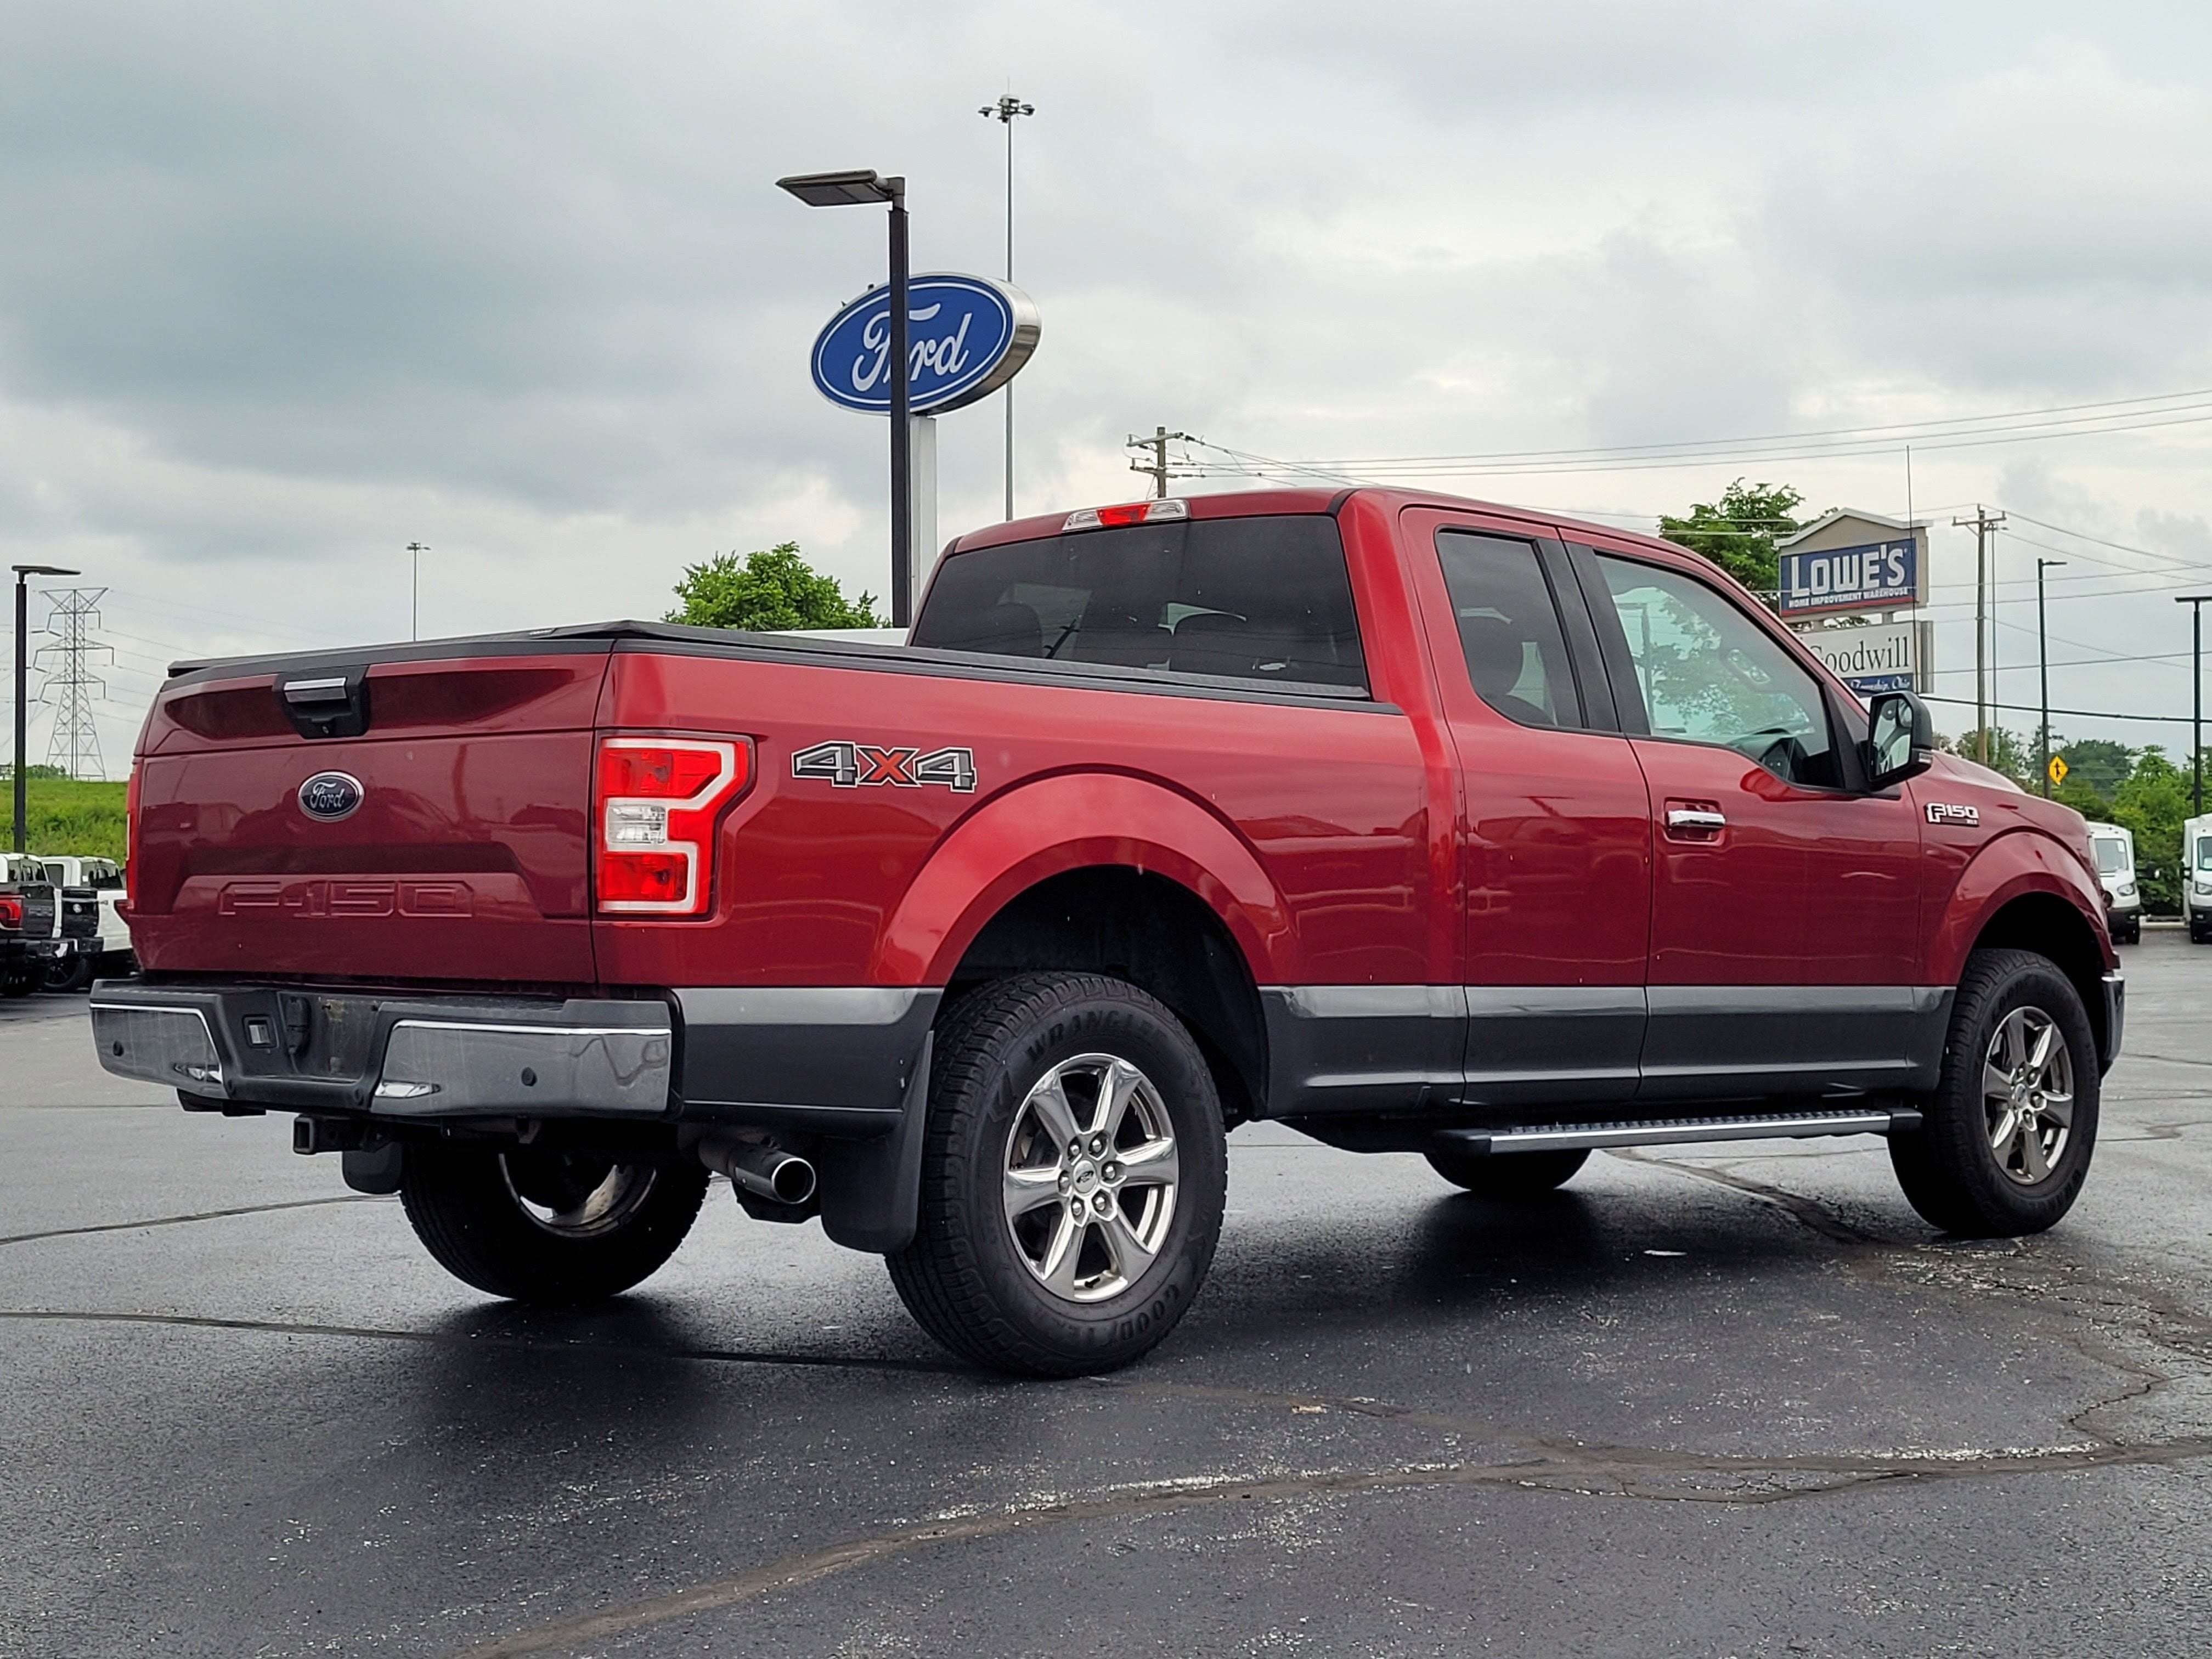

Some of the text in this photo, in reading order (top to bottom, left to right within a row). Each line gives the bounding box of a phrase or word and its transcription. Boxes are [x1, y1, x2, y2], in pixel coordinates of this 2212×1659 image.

[851, 302, 973, 392] Frd
[1791, 544, 1905, 598] LOWE'S
[1788, 587, 1909, 608] HOME IMPROVEMENT WAREHOUSE
[309, 781, 345, 809] Ford
[218, 880, 474, 918] F-150
